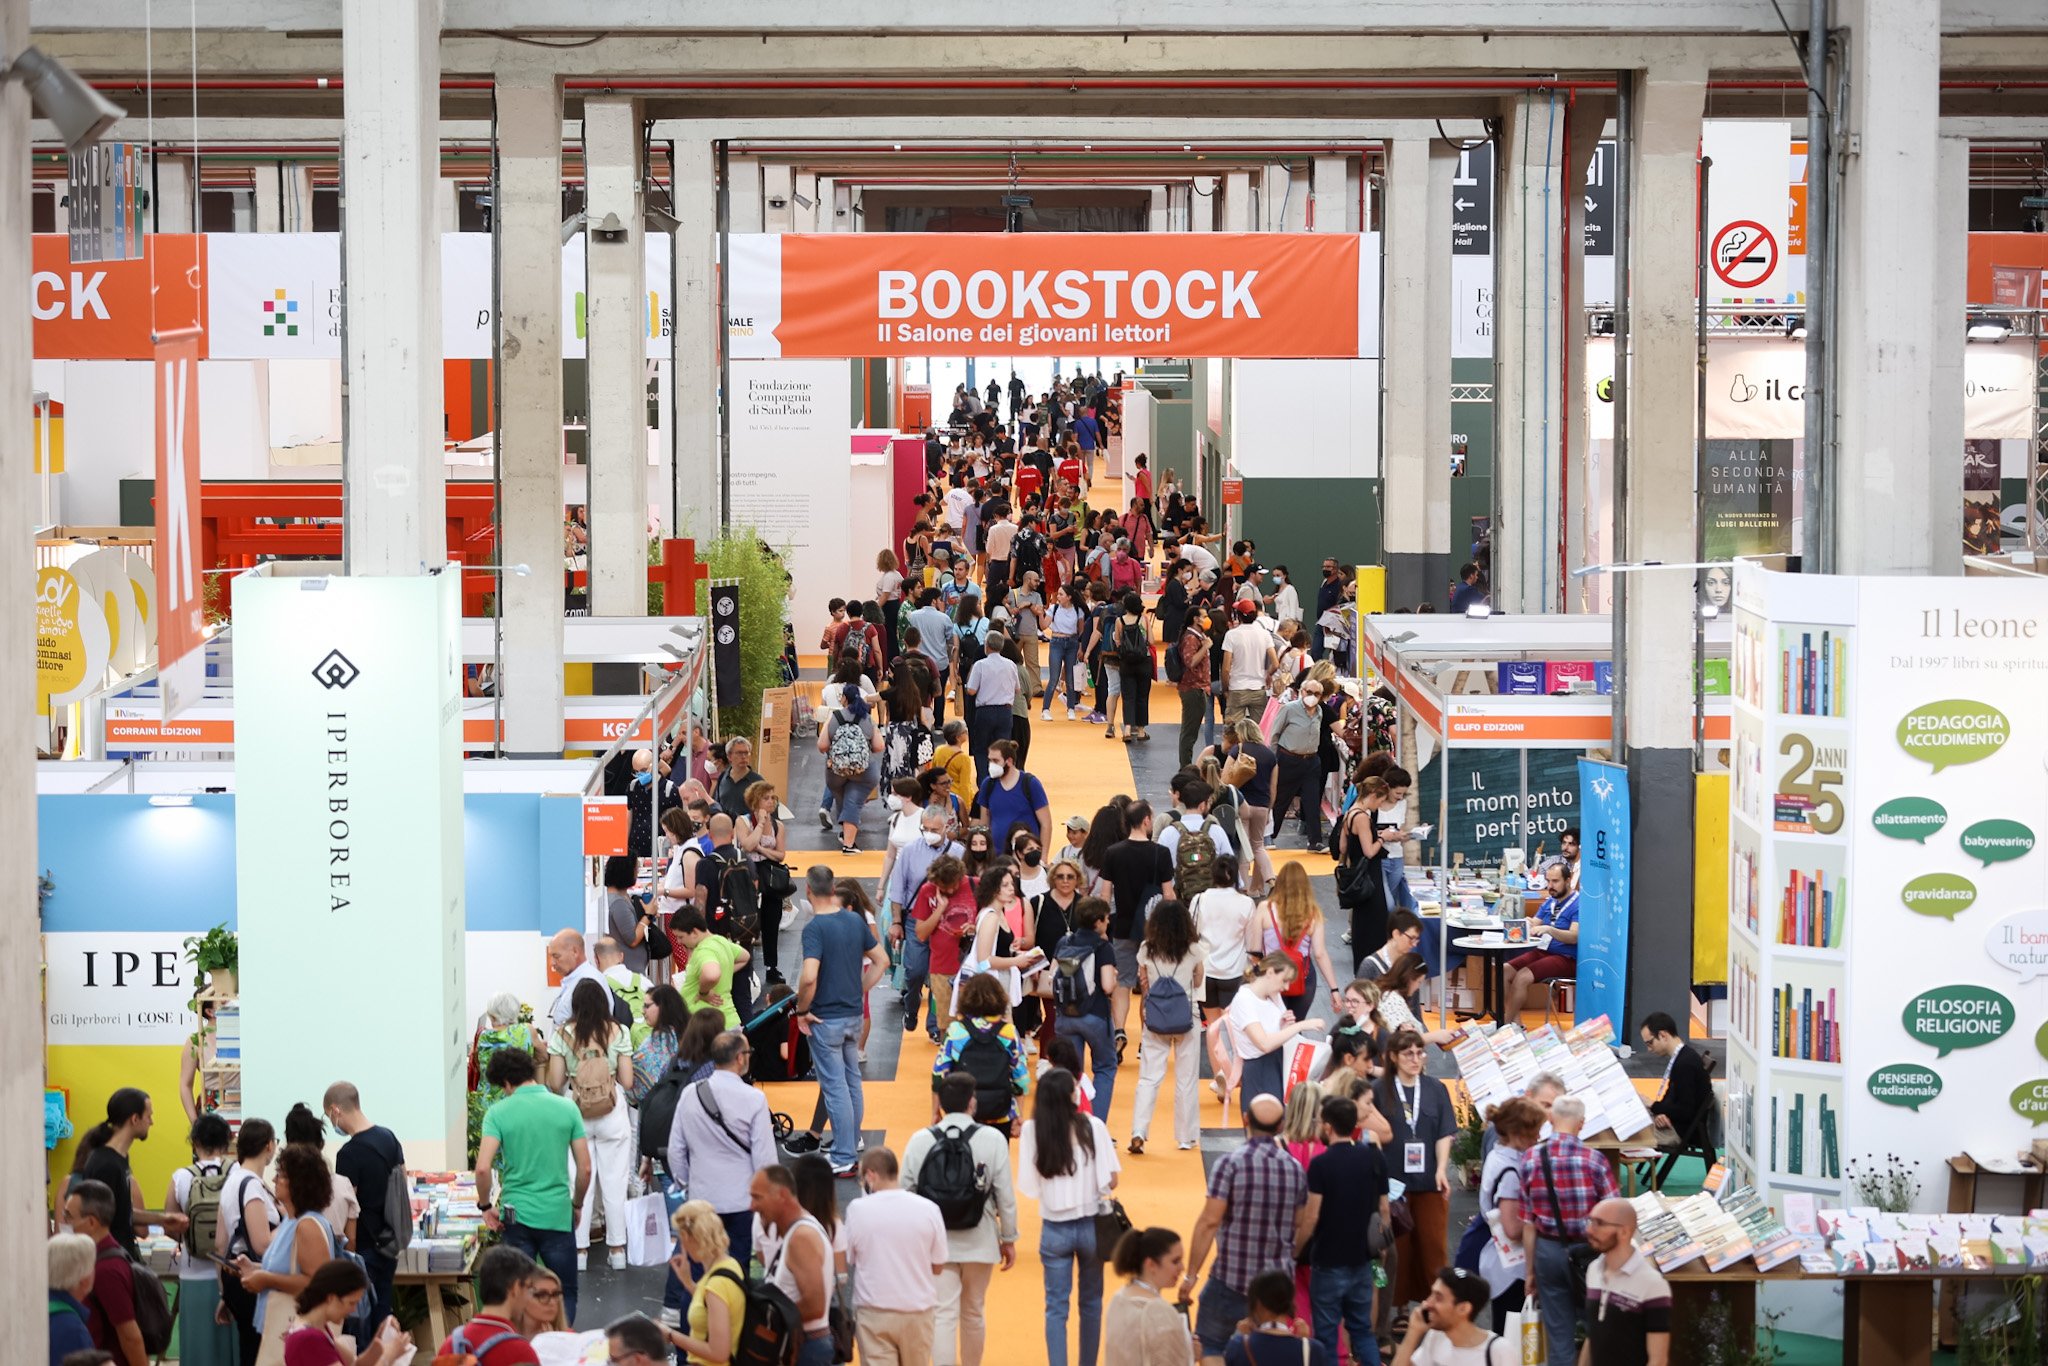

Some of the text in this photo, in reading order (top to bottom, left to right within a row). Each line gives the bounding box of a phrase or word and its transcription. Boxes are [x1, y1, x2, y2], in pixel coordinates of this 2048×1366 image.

[1454, 237, 1472, 246] Hall
[32, 271, 111, 320] CK
[877, 269, 1262, 319] BOOKSTOCK
[897, 322, 976, 343] Salone
[980, 323, 1012, 343] dei
[1018, 323, 1098, 347] giovani
[1103, 323, 1171, 343] lettori
[748, 379, 812, 390] Fondazione
[1766, 379, 1781, 401] il
[748, 391, 811, 404] Compagnia
[748, 404, 812, 415] di San Paolo
[1729, 450, 1769, 461] ALLA
[1711, 466, 1786, 478] SECONDA
[1712, 480, 1784, 494] UMANITÀ
[1920, 608, 2038, 639] Il leone
[1890, 655, 1913, 669] Dal
[1920, 656, 1949, 669] 1997
[1953, 655, 1980, 669] libri
[1984, 659, 1999, 669] su
[1453, 723, 1525, 732] GLIFO EDIZIONI
[1907, 714, 2003, 730] PEDAGOGIA
[112, 726, 202, 736] CORRAINI EDIZIONI
[1904, 732, 2005, 747] ACCUDIMENTO
[1815, 747, 1847, 769] ANNI
[1466, 786, 1573, 814] momento
[327, 712, 351, 913] IPERBOREA
[1874, 813, 1947, 825] allattamento
[1476, 812, 1568, 843] perfetto
[1964, 835, 2034, 849] babywearing
[1904, 887, 1973, 902] gravidanza
[1916, 999, 2002, 1016] FILOSOFIA
[50, 1012, 121, 1028] Gli Iperborei
[138, 1011, 174, 1025] COSE
[1915, 1017, 2001, 1035] RELIGIONE
[1877, 1072, 1934, 1085] PENSIERO
[1871, 1085, 1938, 1097] tradizionale
